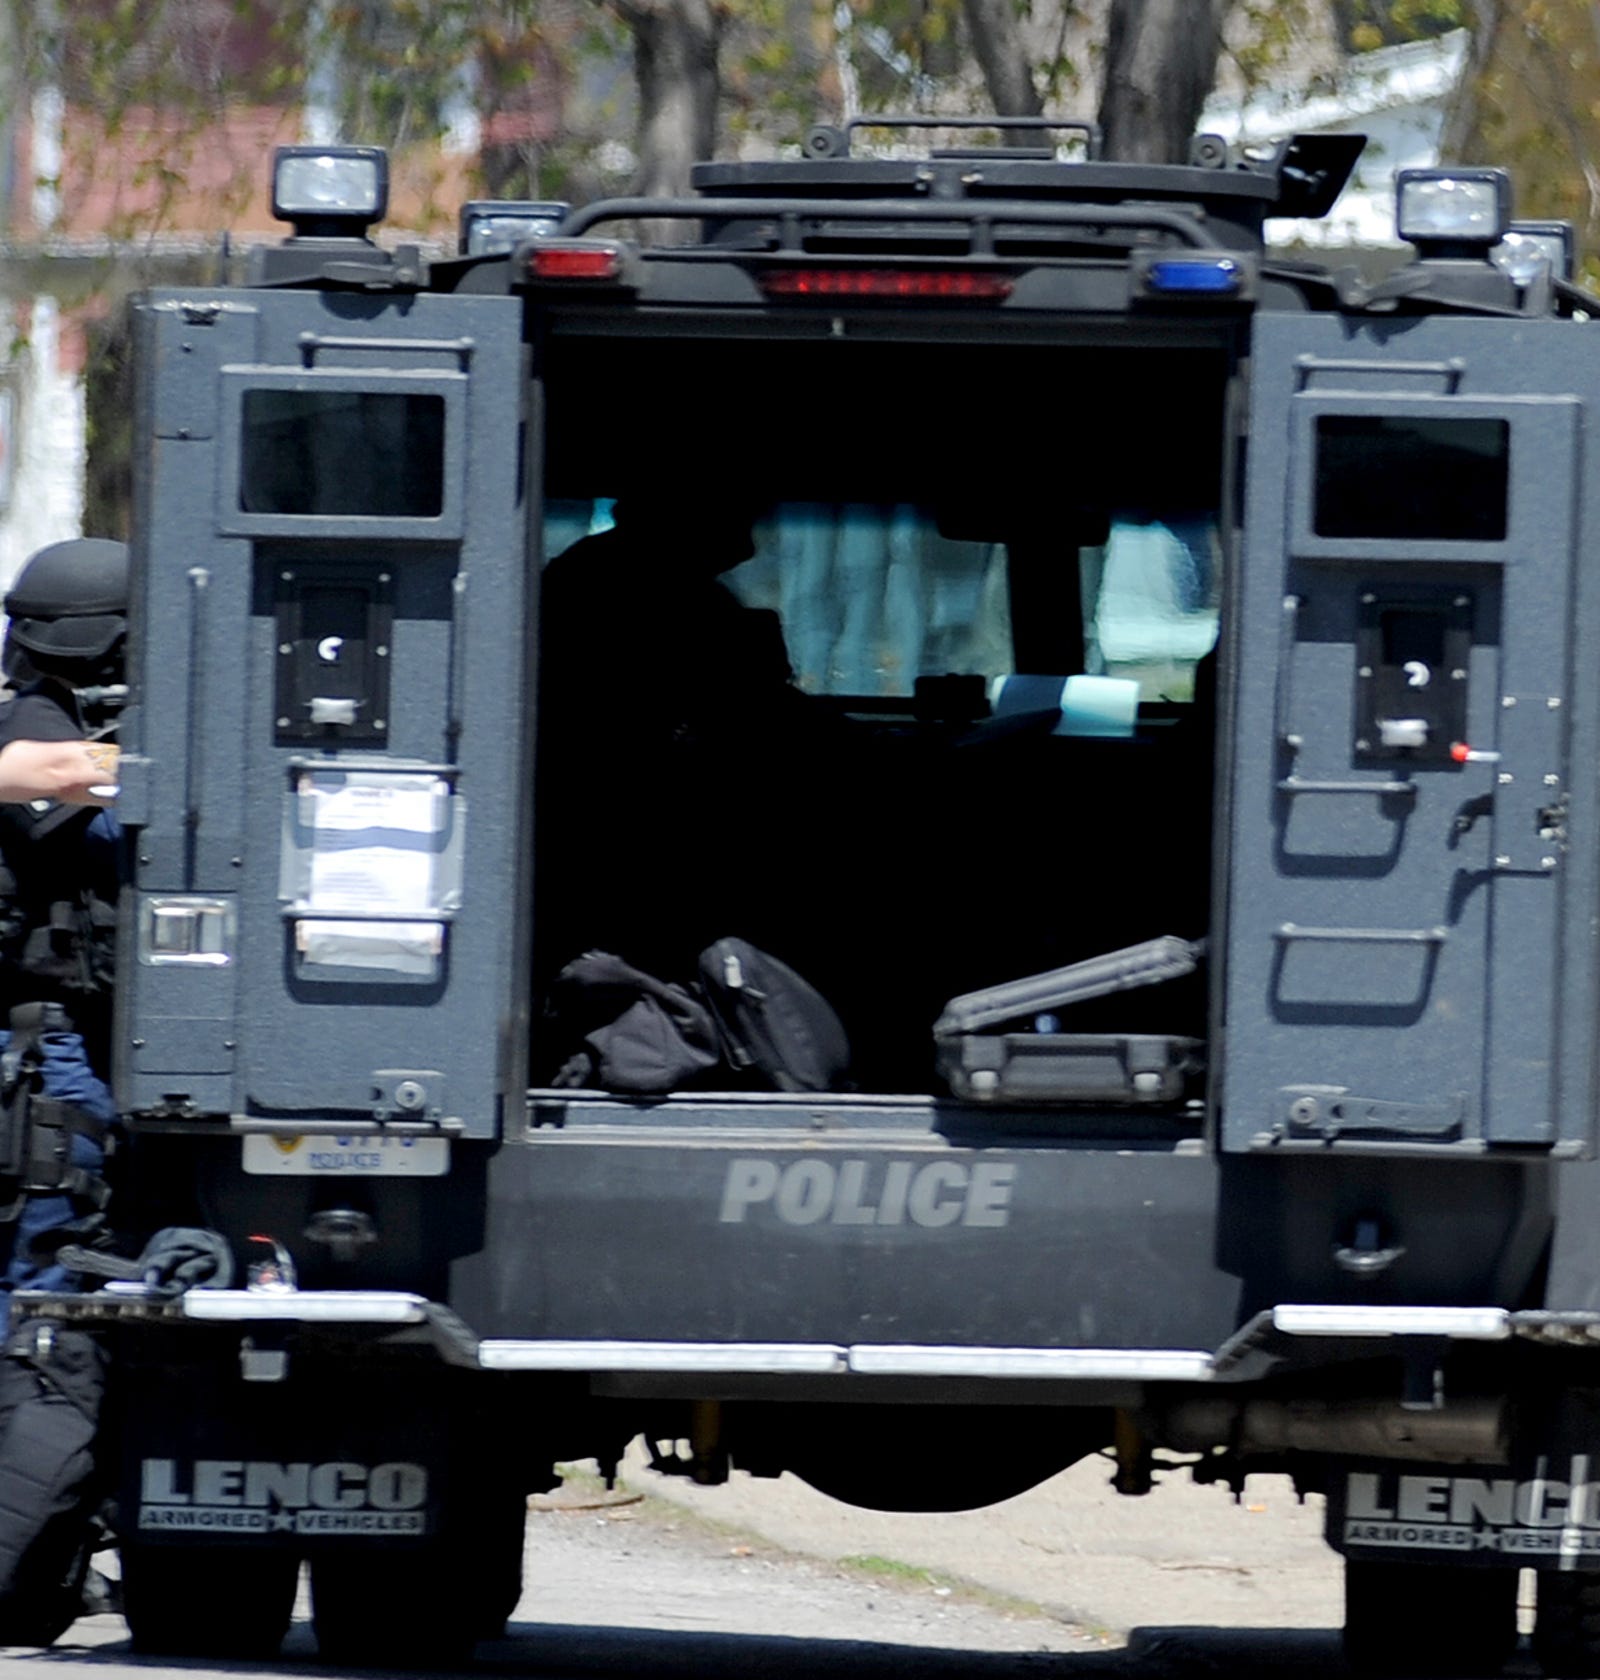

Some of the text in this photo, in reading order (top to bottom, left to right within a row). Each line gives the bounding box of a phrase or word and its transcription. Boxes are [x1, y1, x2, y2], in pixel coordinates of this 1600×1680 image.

[720, 1158, 1017, 1227] POLICE
[141, 1458, 427, 1510] LENCO
[143, 1509, 420, 1530] ARMORED VEHICLES
[1350, 1525, 1466, 1546] ARMORED
